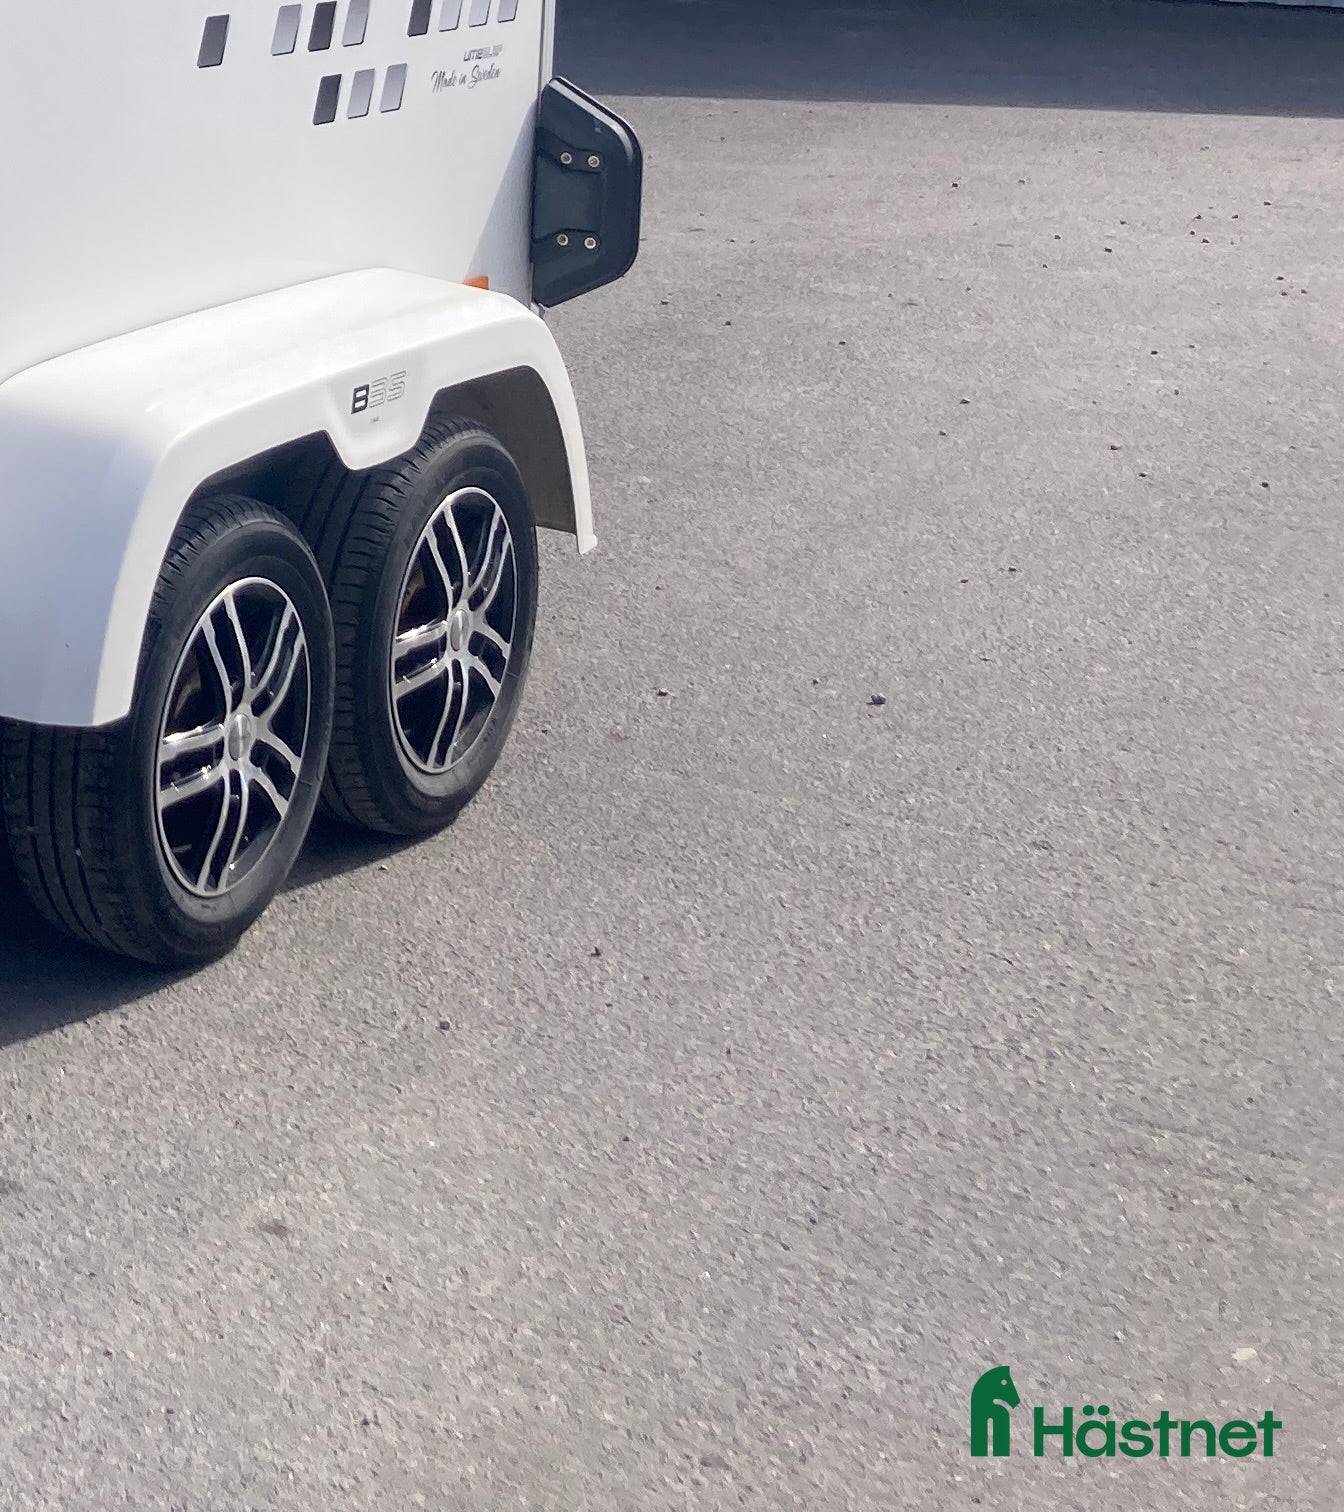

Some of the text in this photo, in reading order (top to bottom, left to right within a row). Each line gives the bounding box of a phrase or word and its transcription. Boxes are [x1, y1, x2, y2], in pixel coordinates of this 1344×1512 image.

[431, 62, 501, 94] Made in Sweden
